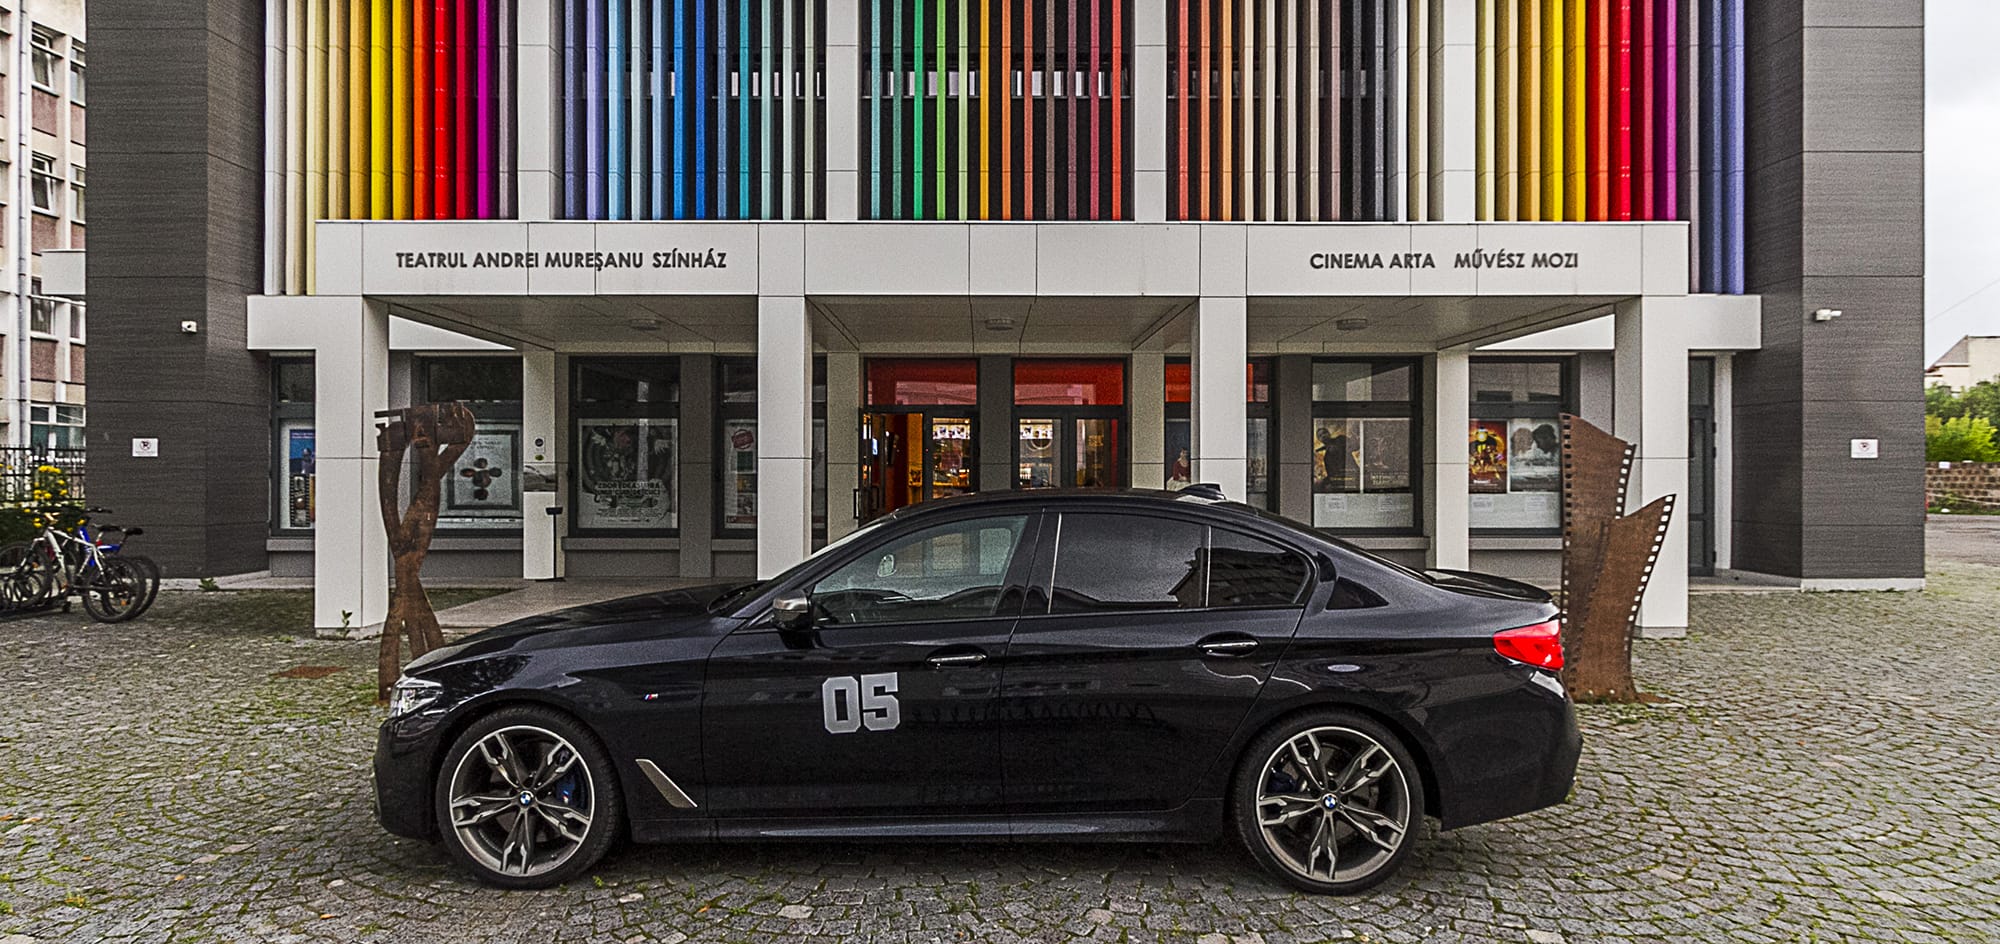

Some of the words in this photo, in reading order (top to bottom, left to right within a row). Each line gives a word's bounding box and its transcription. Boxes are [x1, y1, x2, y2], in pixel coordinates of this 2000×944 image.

[396, 252, 468, 269] TEATRUL
[473, 252, 539, 269] ANDREI
[652, 248, 727, 269] SZÍNHÁZ
[1309, 252, 1384, 269] CINEMA
[1389, 252, 1436, 269] ARTA
[1454, 248, 1525, 269] MŰVÉSZ
[1531, 252, 1579, 269] MOZI
[822, 672, 900, 734] 05
